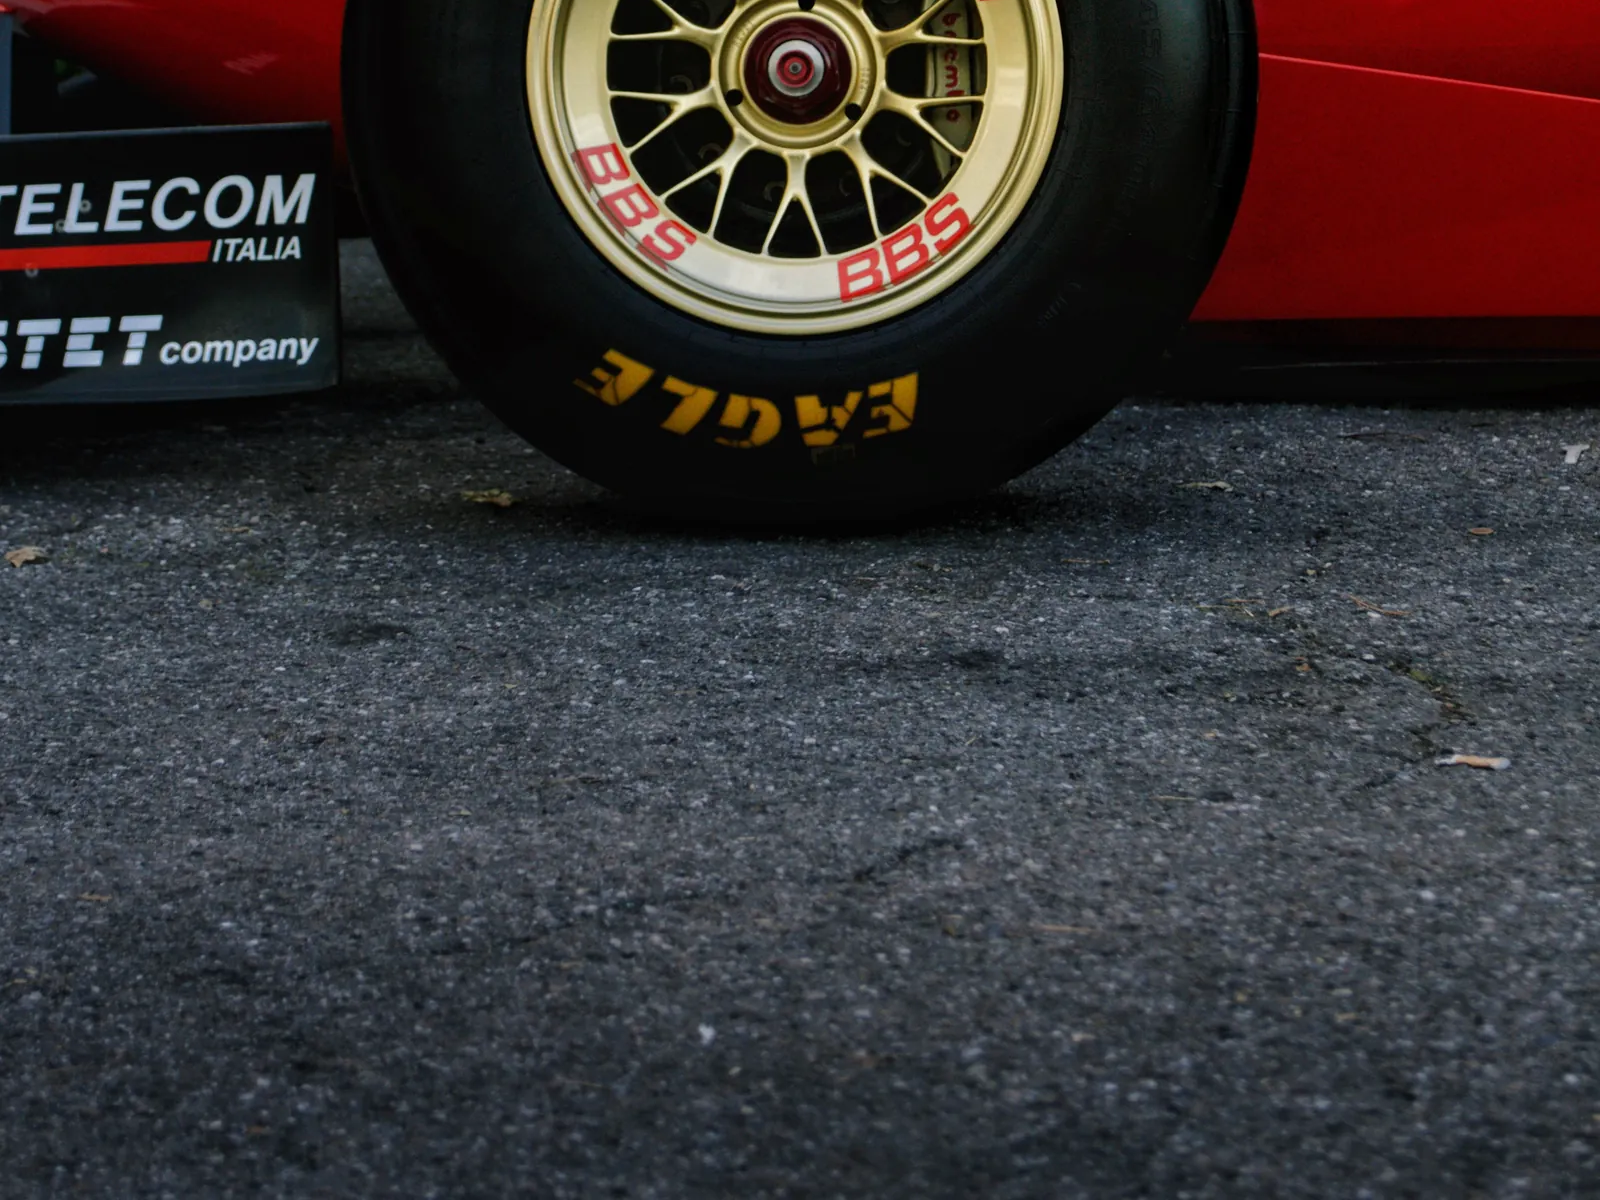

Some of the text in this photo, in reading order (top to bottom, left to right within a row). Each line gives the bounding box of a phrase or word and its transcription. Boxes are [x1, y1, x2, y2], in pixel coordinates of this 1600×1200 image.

[212, 236, 302, 263] ITALIA
[574, 142, 697, 268] BBS
[836, 192, 974, 303] BBS
[0, 314, 320, 369] TET company
[573, 348, 919, 448] EAGLE
